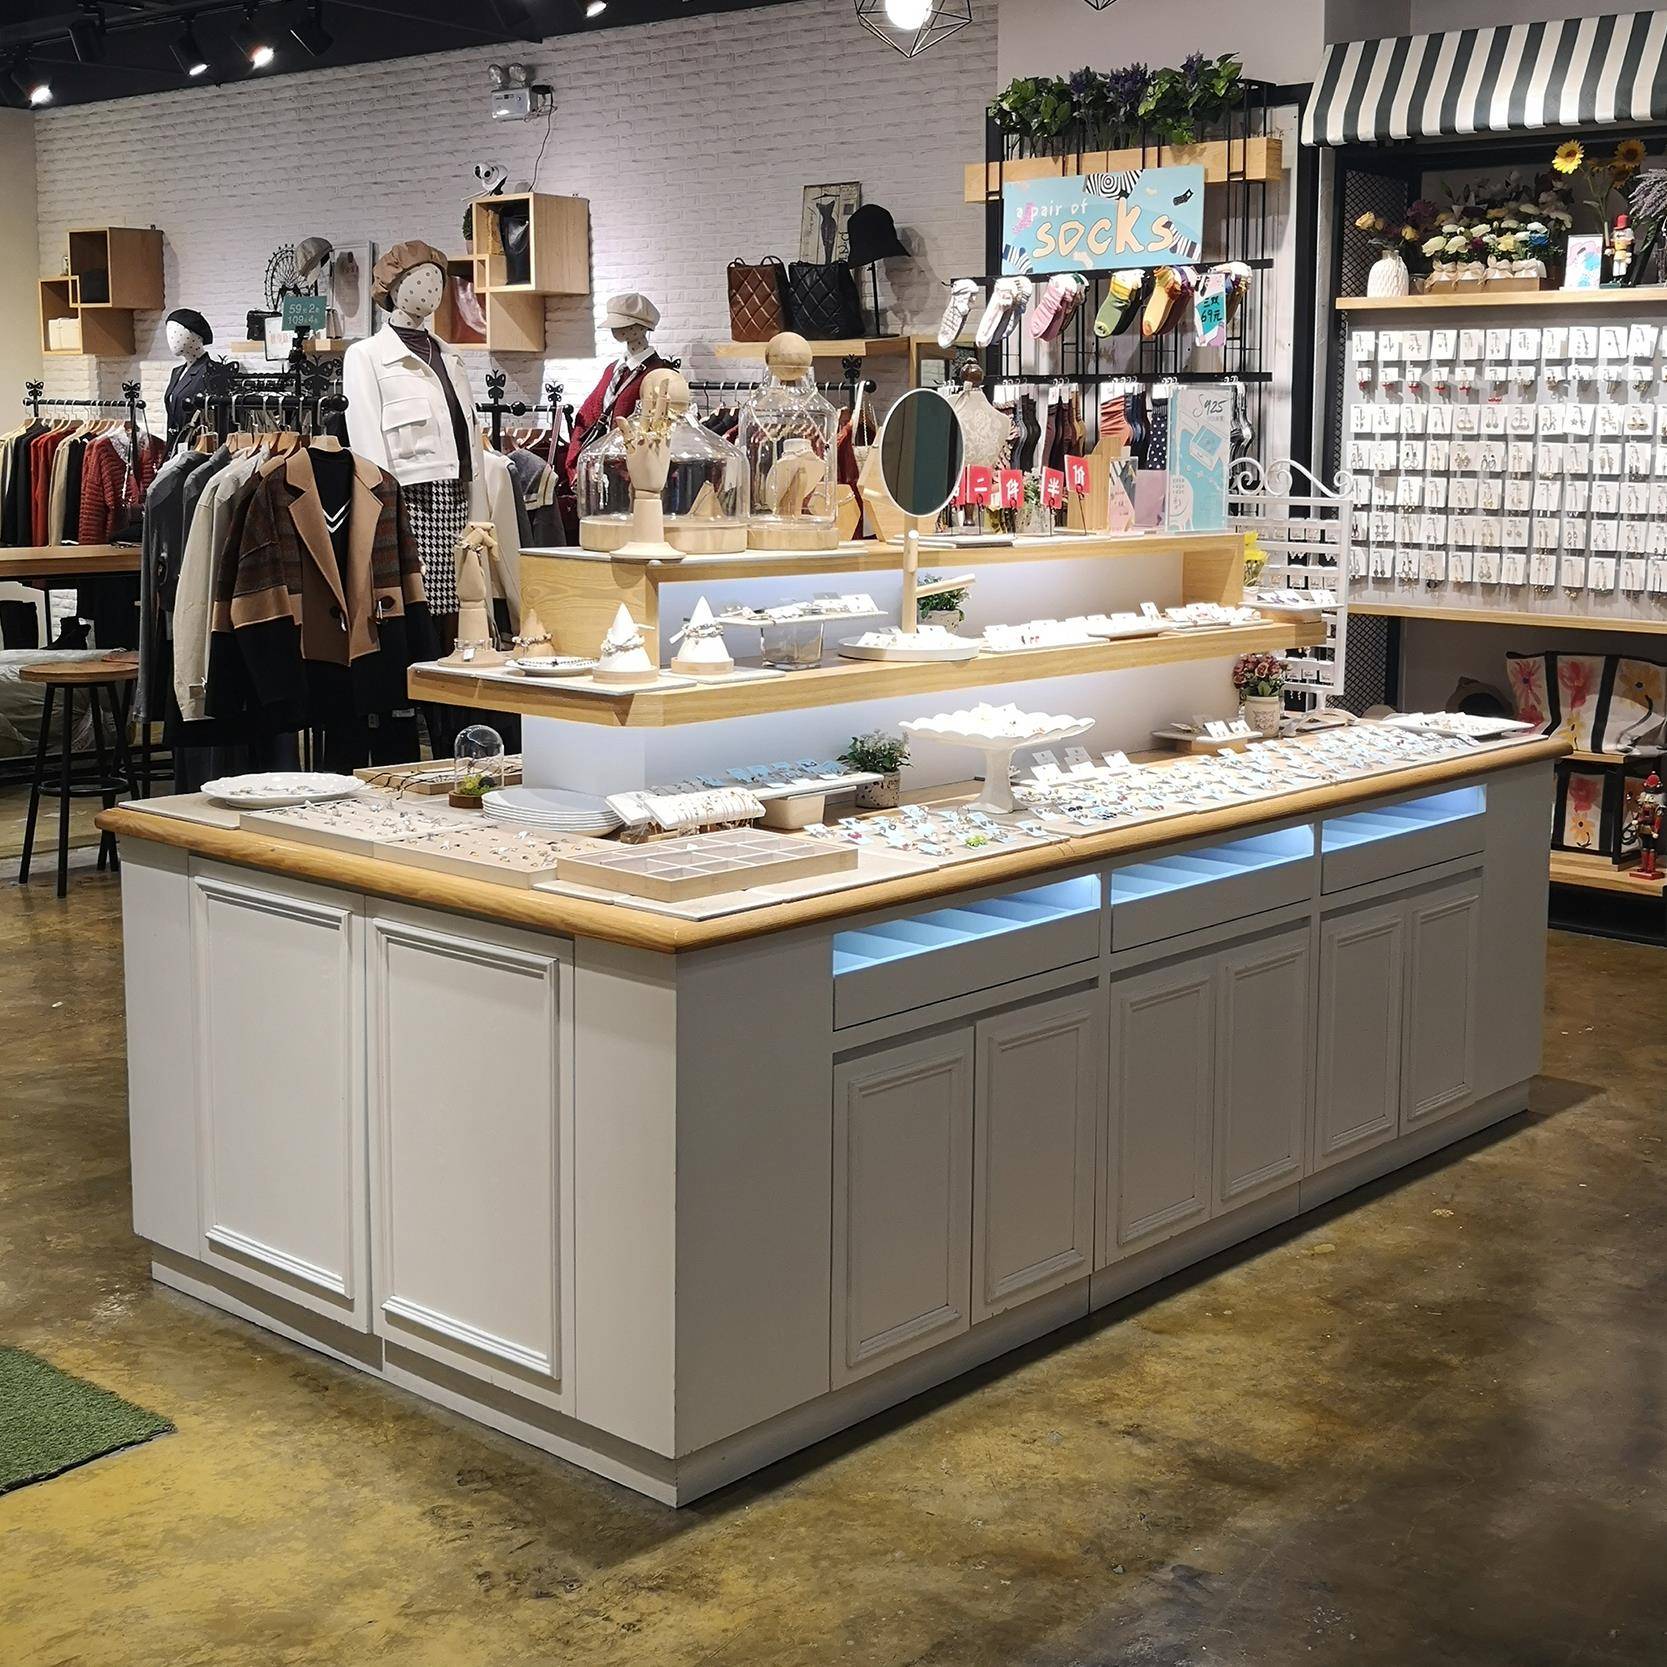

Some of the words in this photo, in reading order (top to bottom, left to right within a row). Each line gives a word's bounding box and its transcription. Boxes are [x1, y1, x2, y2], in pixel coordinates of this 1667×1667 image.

[1015, 206, 1024, 219] a
[1030, 204, 1063, 222] pair
[1071, 200, 1089, 215] of
[1200, 309, 1224, 323] 69元
[1192, 393, 1228, 418] S925
